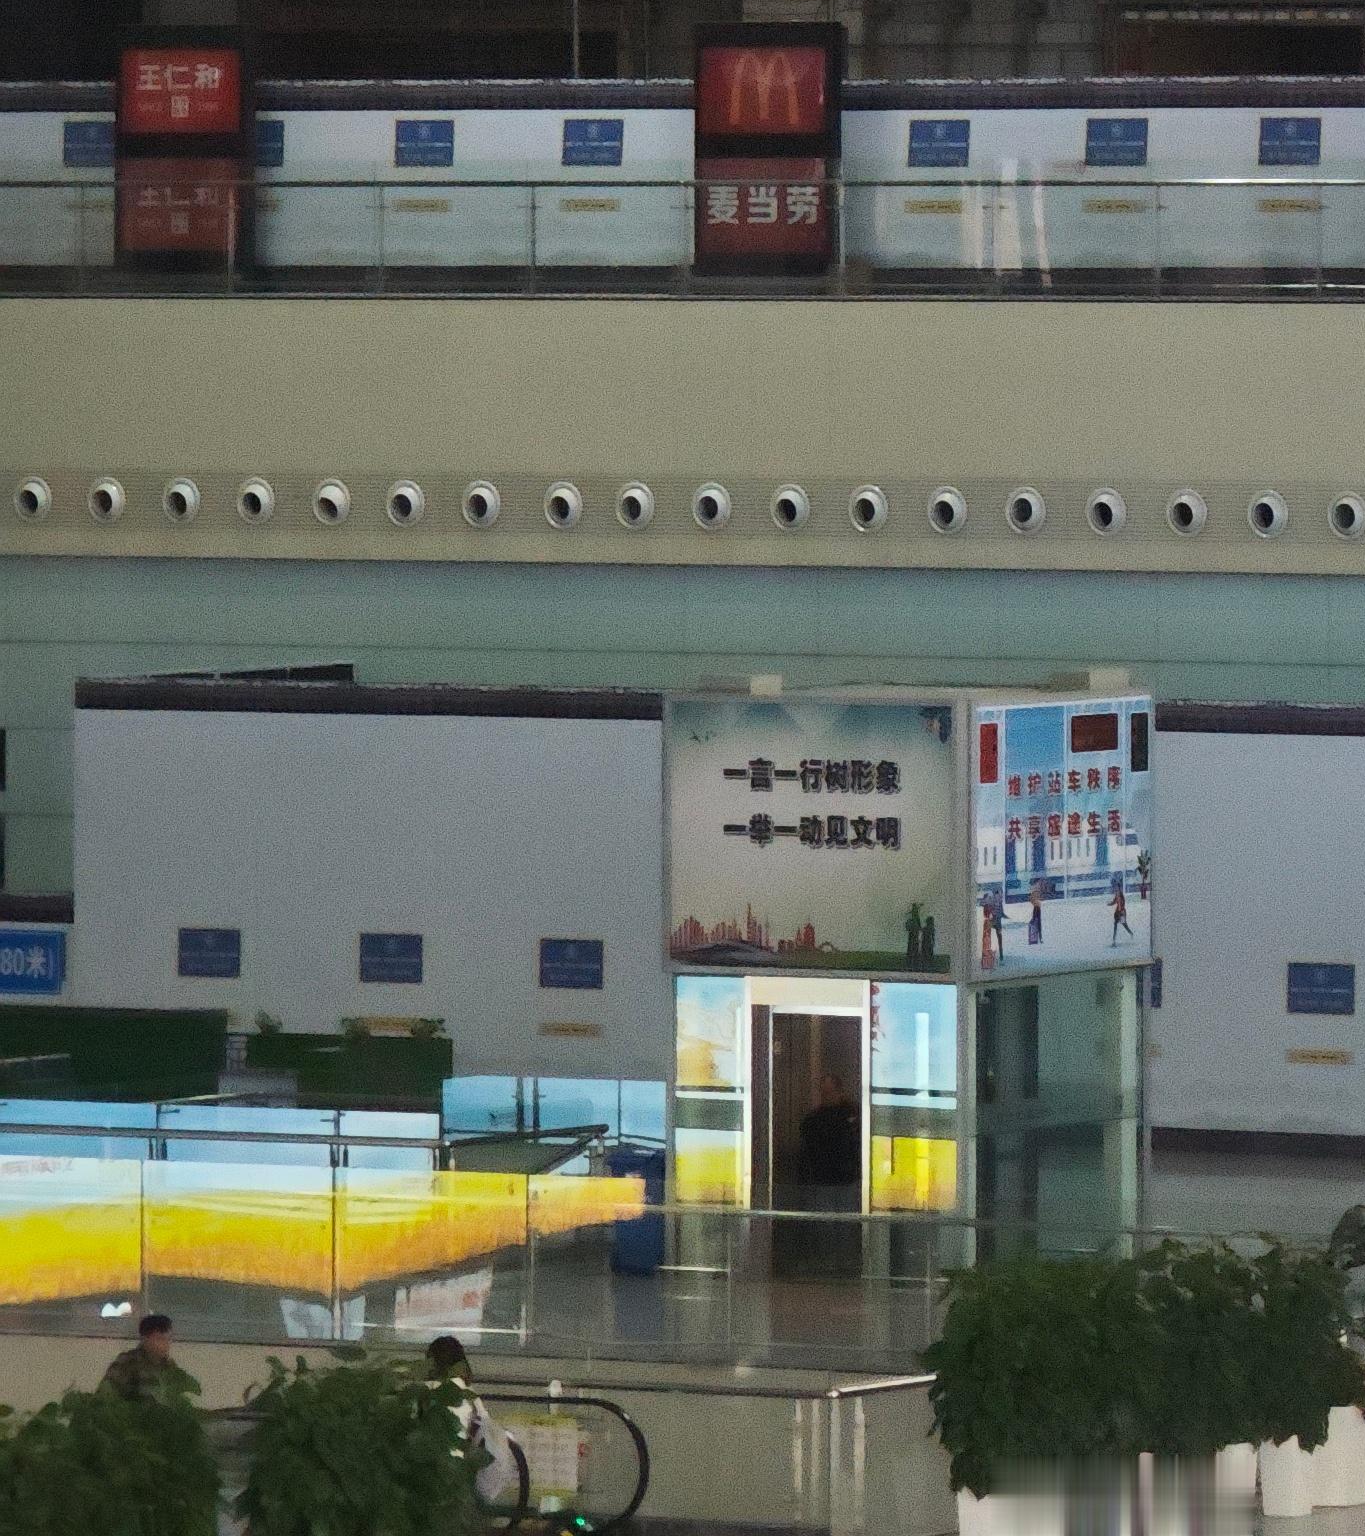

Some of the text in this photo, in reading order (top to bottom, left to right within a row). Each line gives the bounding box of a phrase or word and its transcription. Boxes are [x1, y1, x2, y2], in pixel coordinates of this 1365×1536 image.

[135, 63, 223, 92] 王仁和
[706, 185, 820, 225] 麦当劳
[723, 759, 901, 794] 一言一行树形象
[1008, 765, 1121, 798] 维护站车秩序
[723, 813, 901, 850] 一举一动见文明
[1008, 809, 1121, 840] 共享旅途生活
